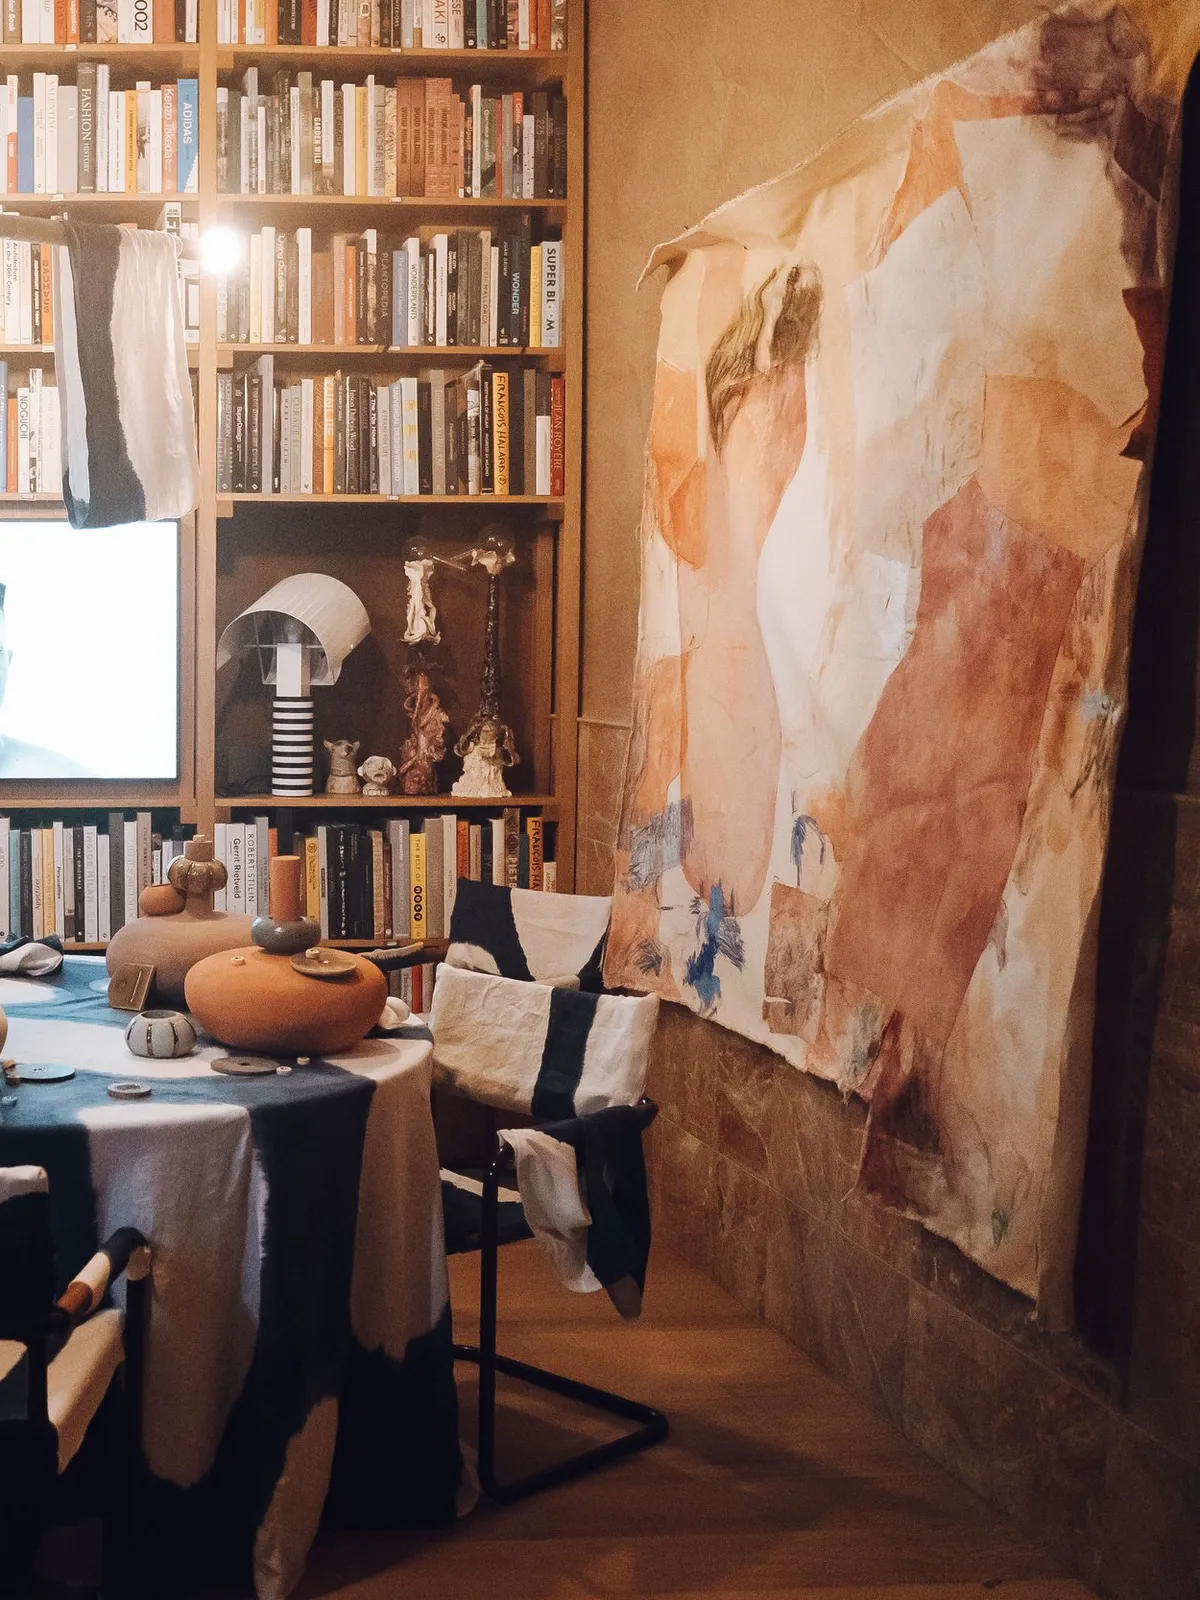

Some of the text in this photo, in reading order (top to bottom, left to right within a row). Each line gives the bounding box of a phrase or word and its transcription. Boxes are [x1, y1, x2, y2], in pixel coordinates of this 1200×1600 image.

[135, 0, 148, 31] 002
[81, 88, 92, 141] FASHION
[163, 88, 174, 158] Kenzo Takada
[182, 102, 193, 144] ADIDAS
[313, 117, 322, 164] GARDEN WILD
[374, 111, 384, 173] CONCRETE
[277, 235, 285, 292] Living Outside
[381, 253, 389, 318] PLANTOPEDIA
[547, 248, 556, 287] SUPER
[410, 263, 418, 320] WONDERPLANTS
[512, 272, 520, 315] WONDER
[19, 395, 28, 440] NOGUCHI
[553, 403, 562, 429] JEAN
[496, 430, 507, 473] HALARD
[86, 870, 94, 903] MILAN
[508, 857, 517, 880] PIET
